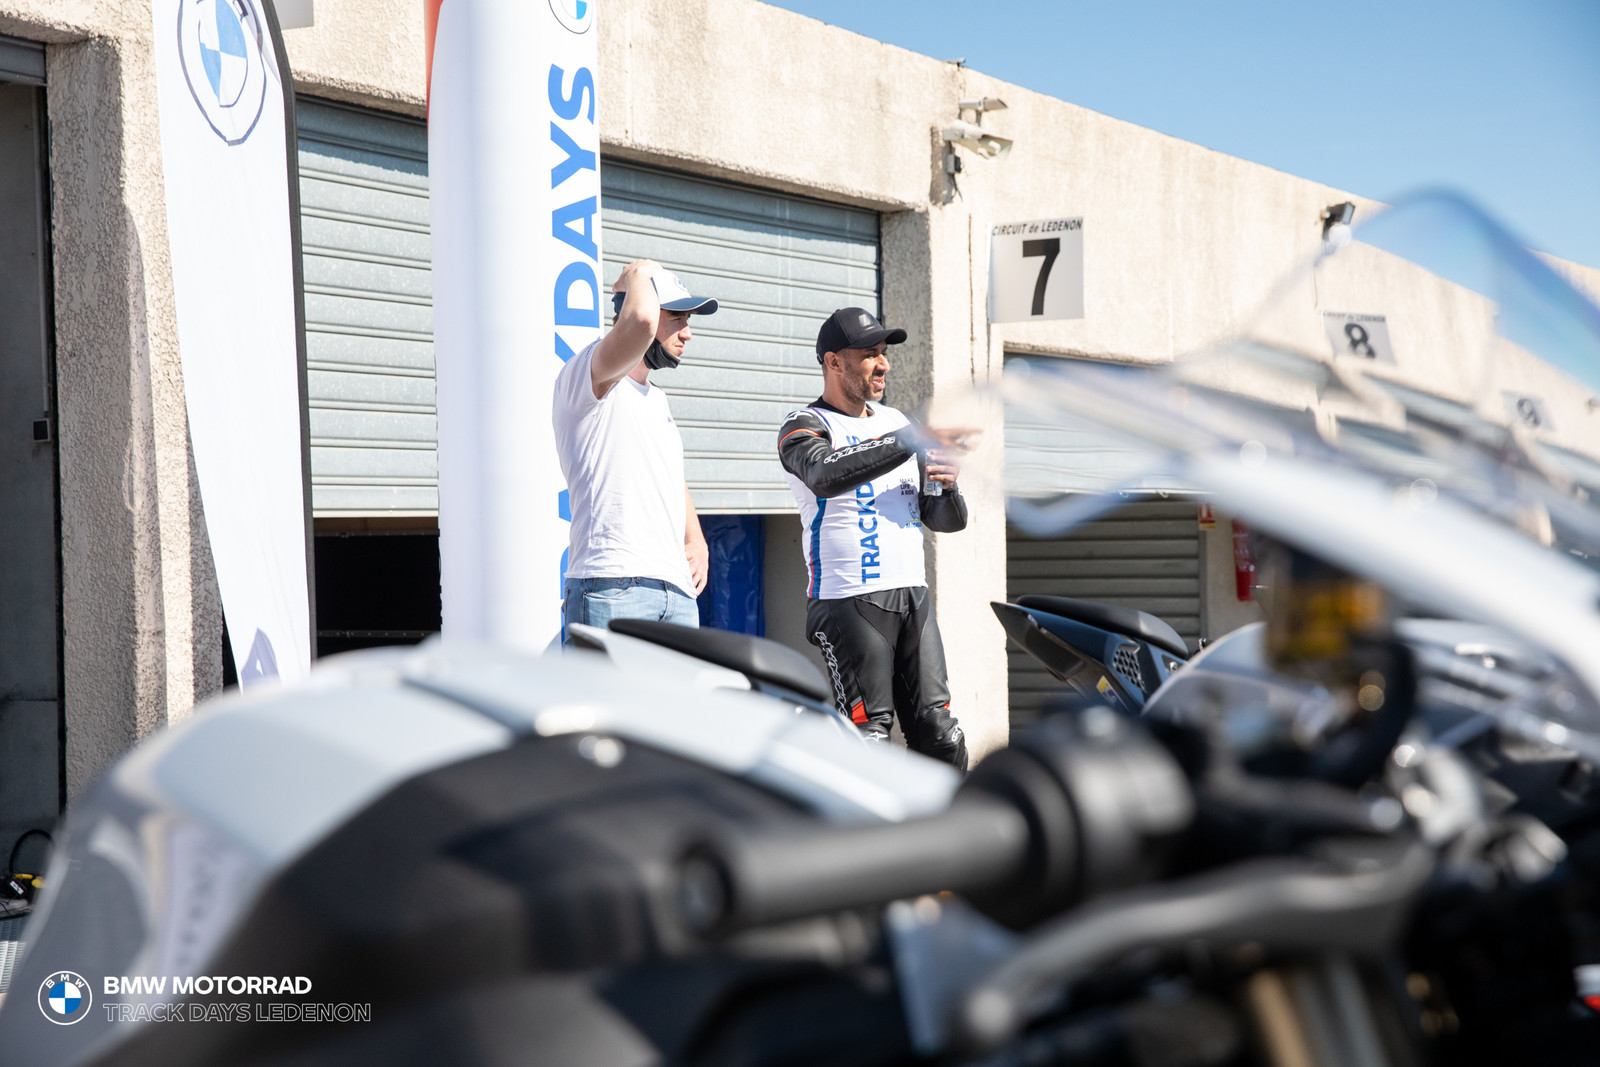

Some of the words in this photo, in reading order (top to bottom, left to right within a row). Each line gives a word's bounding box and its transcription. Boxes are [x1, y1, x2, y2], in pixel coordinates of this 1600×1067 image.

[992, 223, 1027, 236] CIRCUIT
[1041, 219, 1083, 232] LEDENON
[1023, 238, 1060, 315] 7
[1344, 323, 1376, 359] 8
